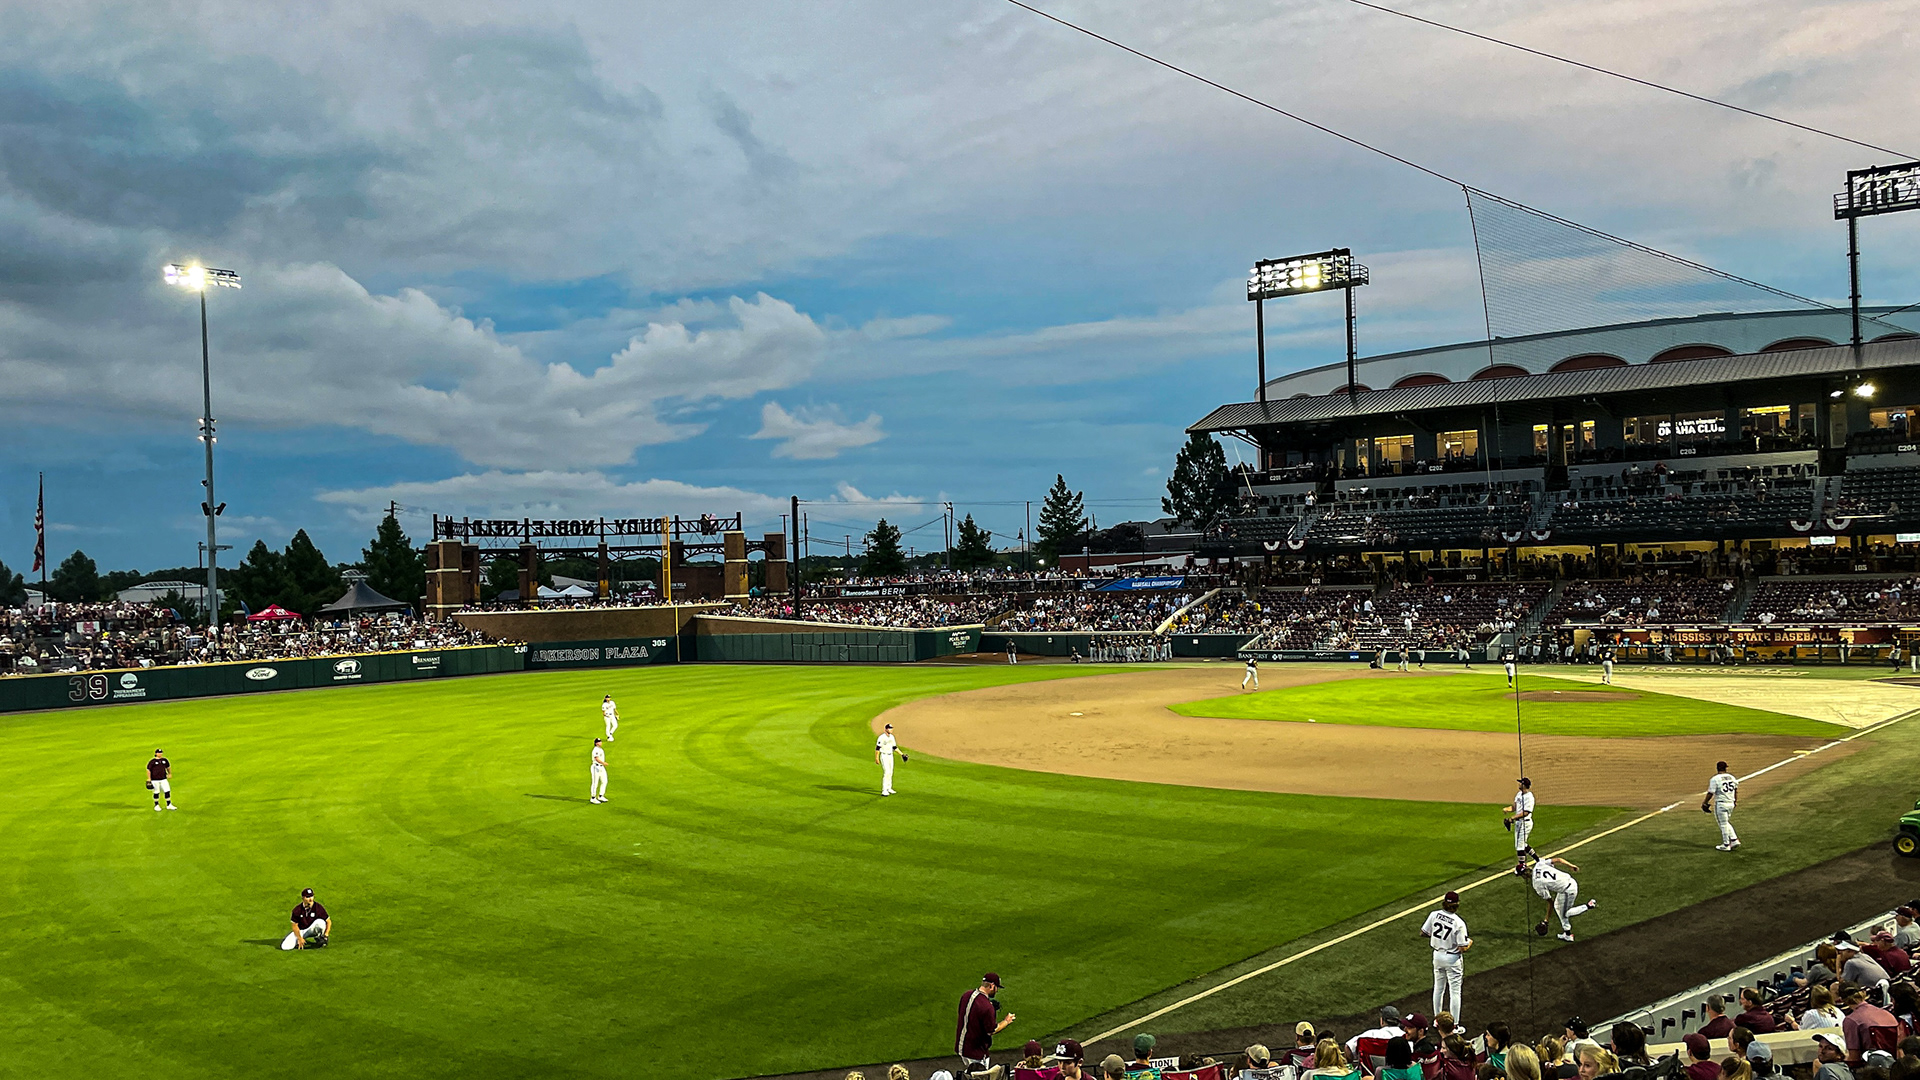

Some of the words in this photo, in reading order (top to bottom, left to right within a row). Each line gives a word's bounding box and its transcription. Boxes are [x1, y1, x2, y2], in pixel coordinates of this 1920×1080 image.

[881, 587, 906, 595] BERM
[1737, 632, 1771, 642] STATE
[1774, 632, 1834, 642] BASEBALL
[651, 639, 667, 647] 305
[514, 645, 528, 654] 330
[531, 647, 600, 662] ADKERSON
[605, 645, 649, 660] PLAZA
[251, 669, 271, 678] Ford
[69, 674, 109, 701] 39
[1722, 781, 1735, 793] 35
[1542, 870, 1556, 880] 2
[1433, 922, 1452, 941] 27
